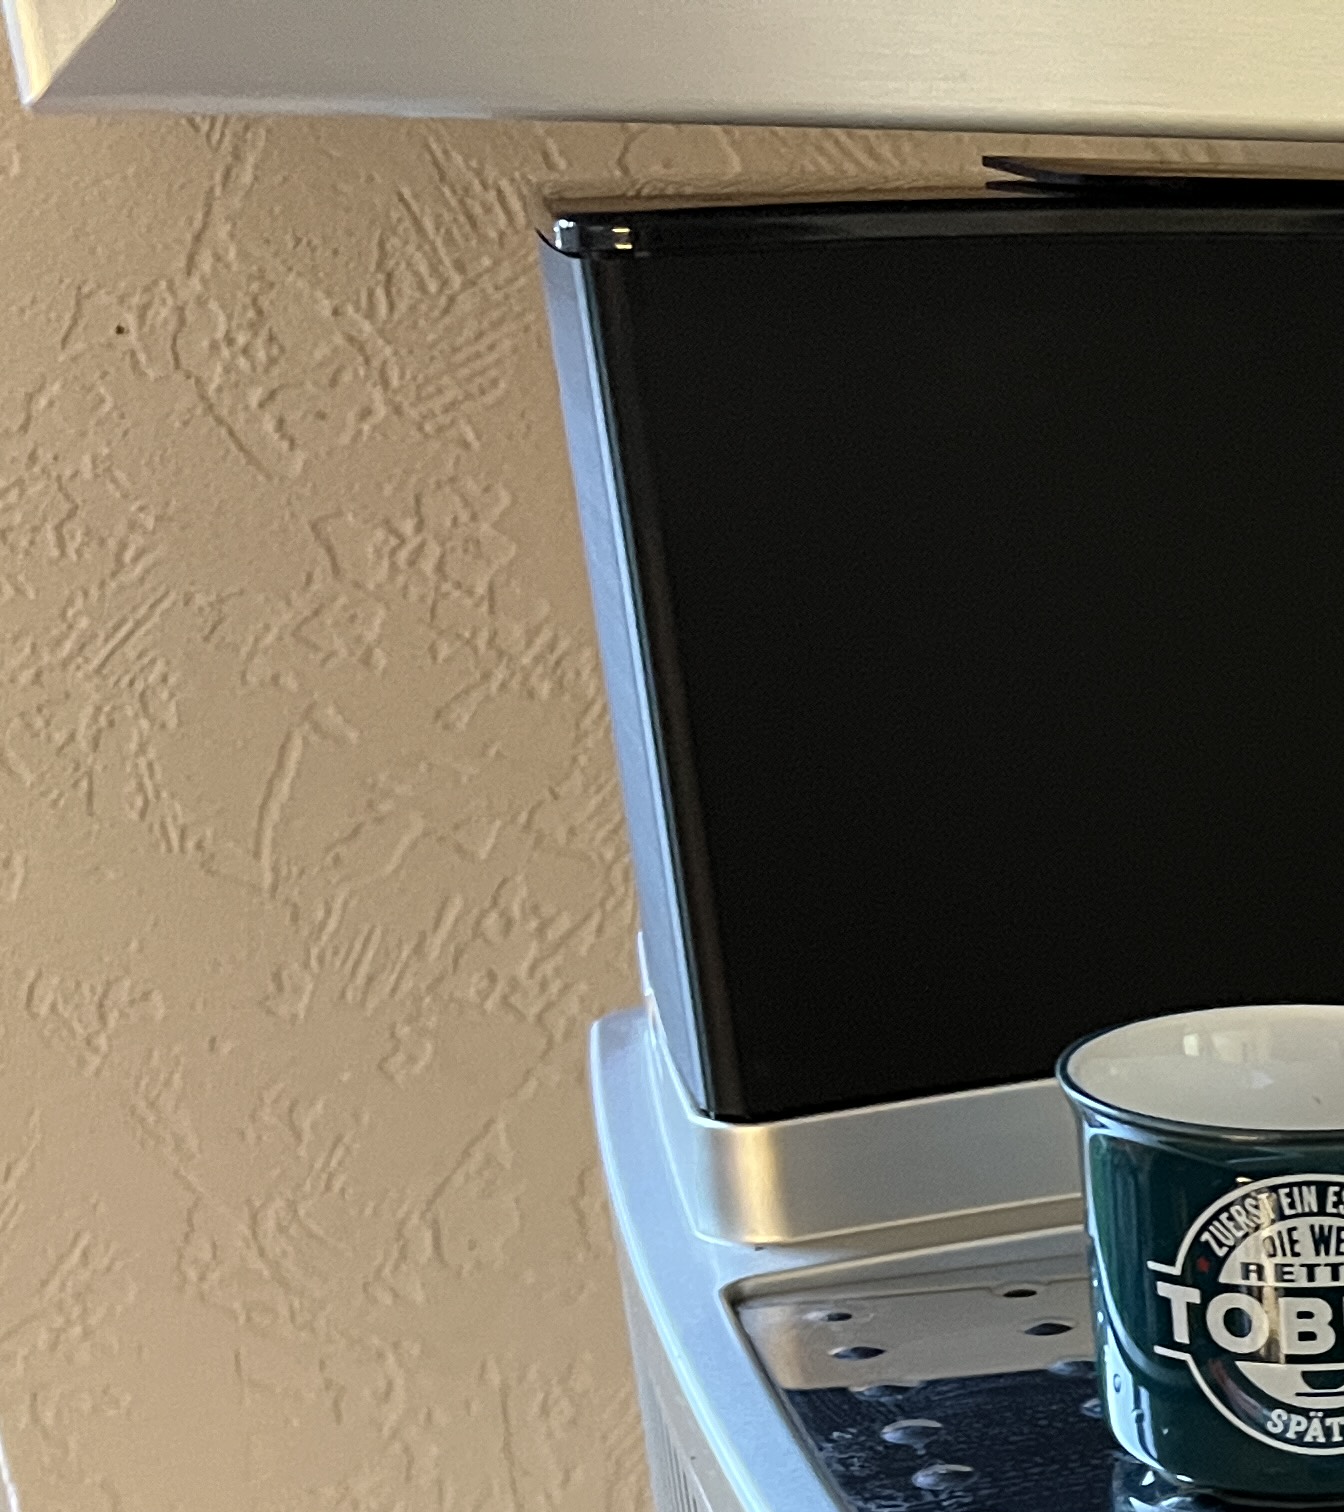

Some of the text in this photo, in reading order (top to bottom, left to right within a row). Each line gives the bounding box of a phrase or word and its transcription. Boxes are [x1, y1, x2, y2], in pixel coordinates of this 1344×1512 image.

[1201, 1190, 1277, 1257] ZUERST
[1281, 1185, 1318, 1216] EIN
[1264, 1225, 1301, 1258] DIE
